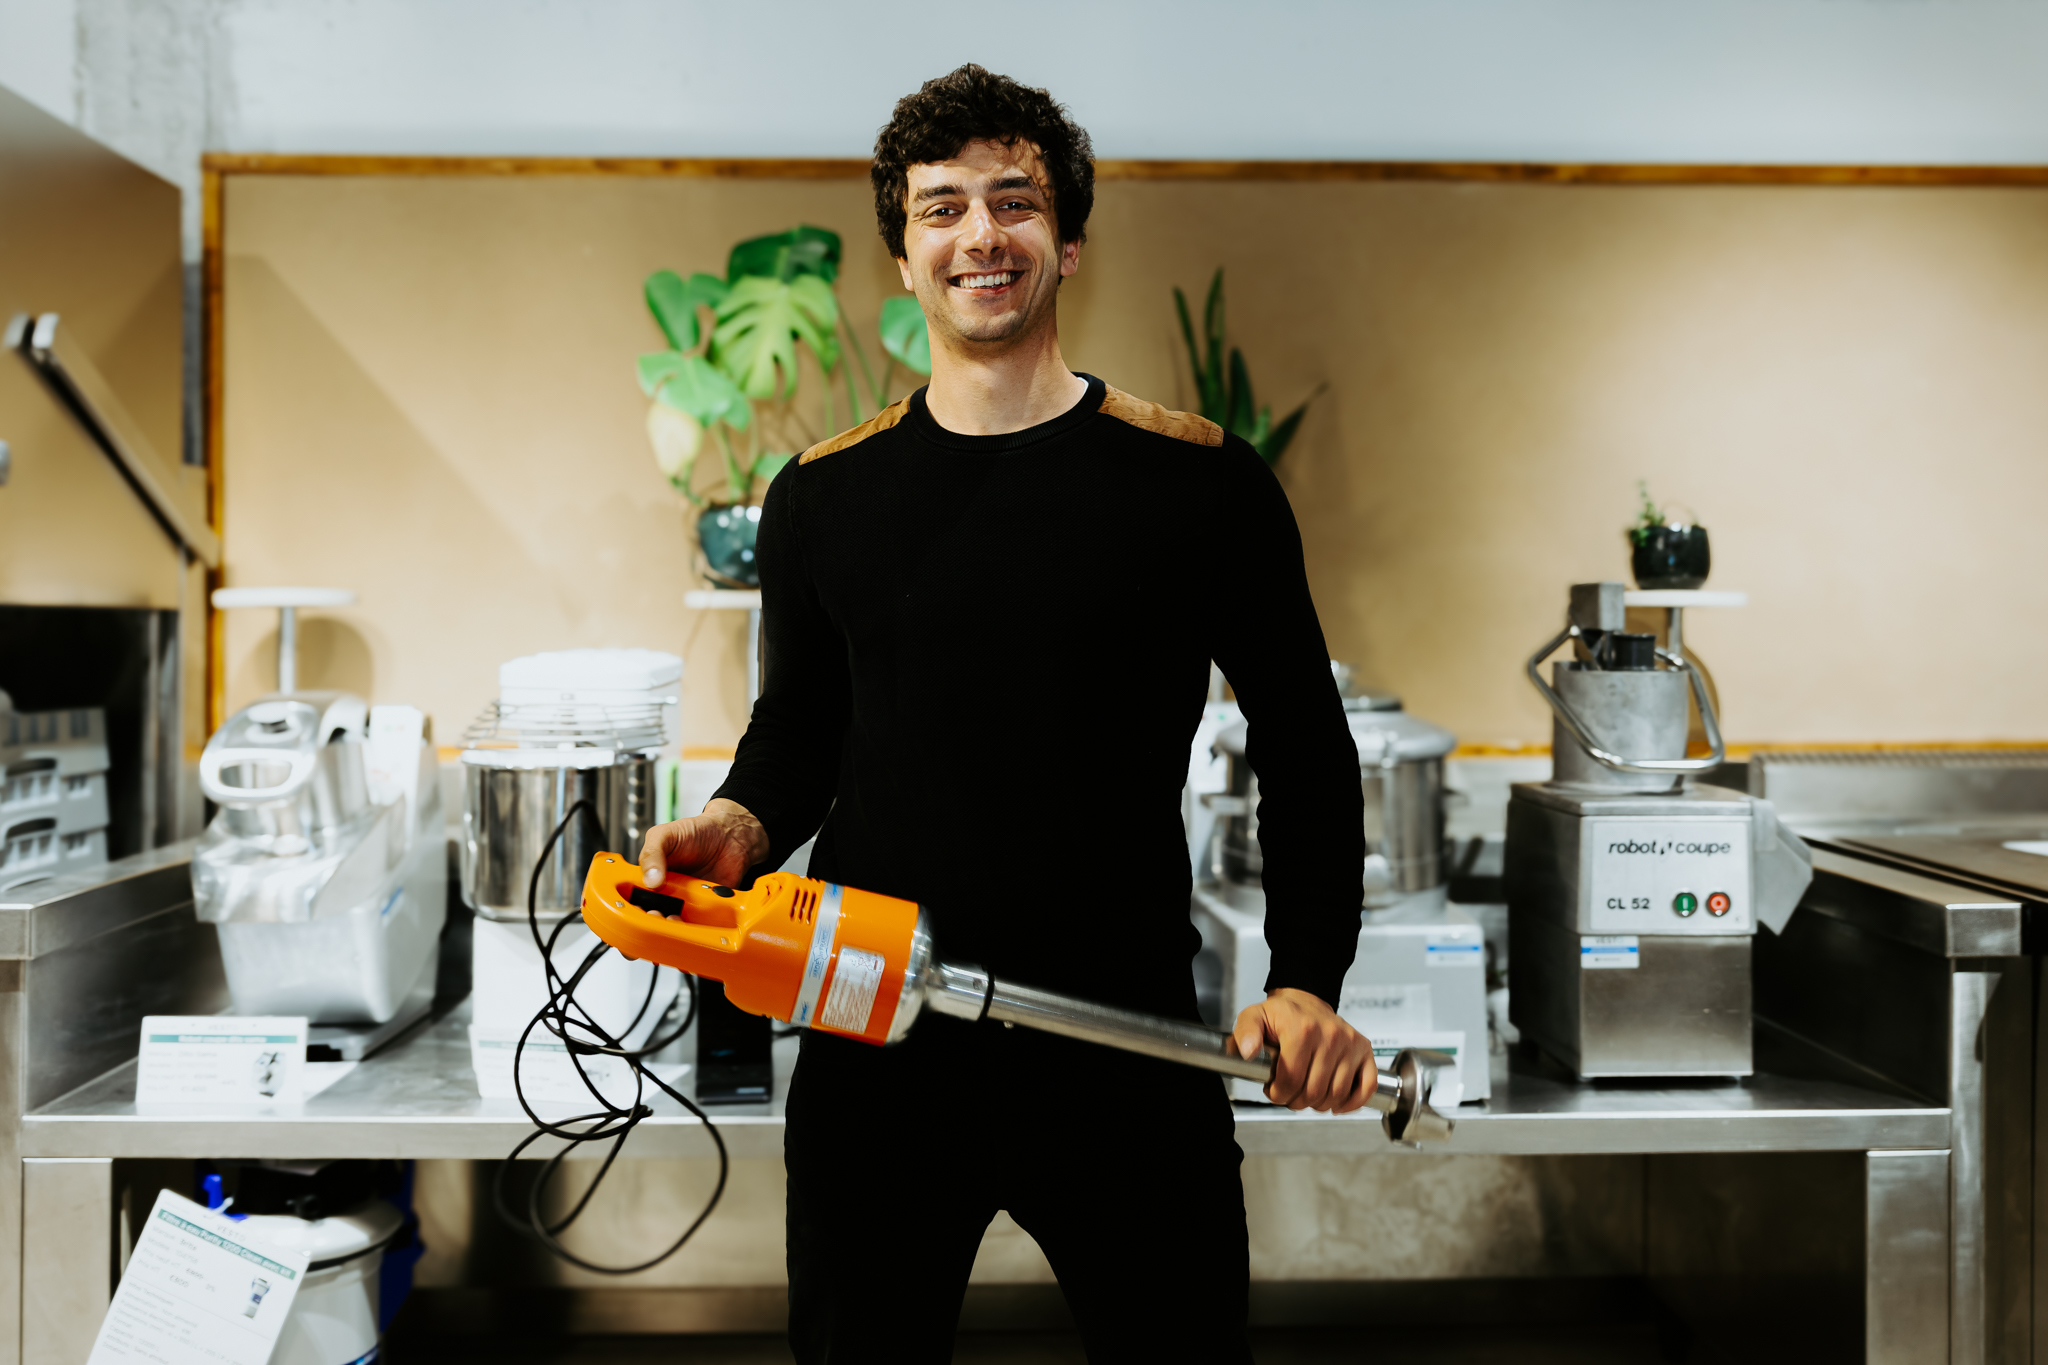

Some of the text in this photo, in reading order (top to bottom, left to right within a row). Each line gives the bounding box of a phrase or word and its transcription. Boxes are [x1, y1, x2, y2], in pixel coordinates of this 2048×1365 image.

[1608, 840, 1731, 856] robot coupe
[1607, 898, 1650, 909] CL 52
